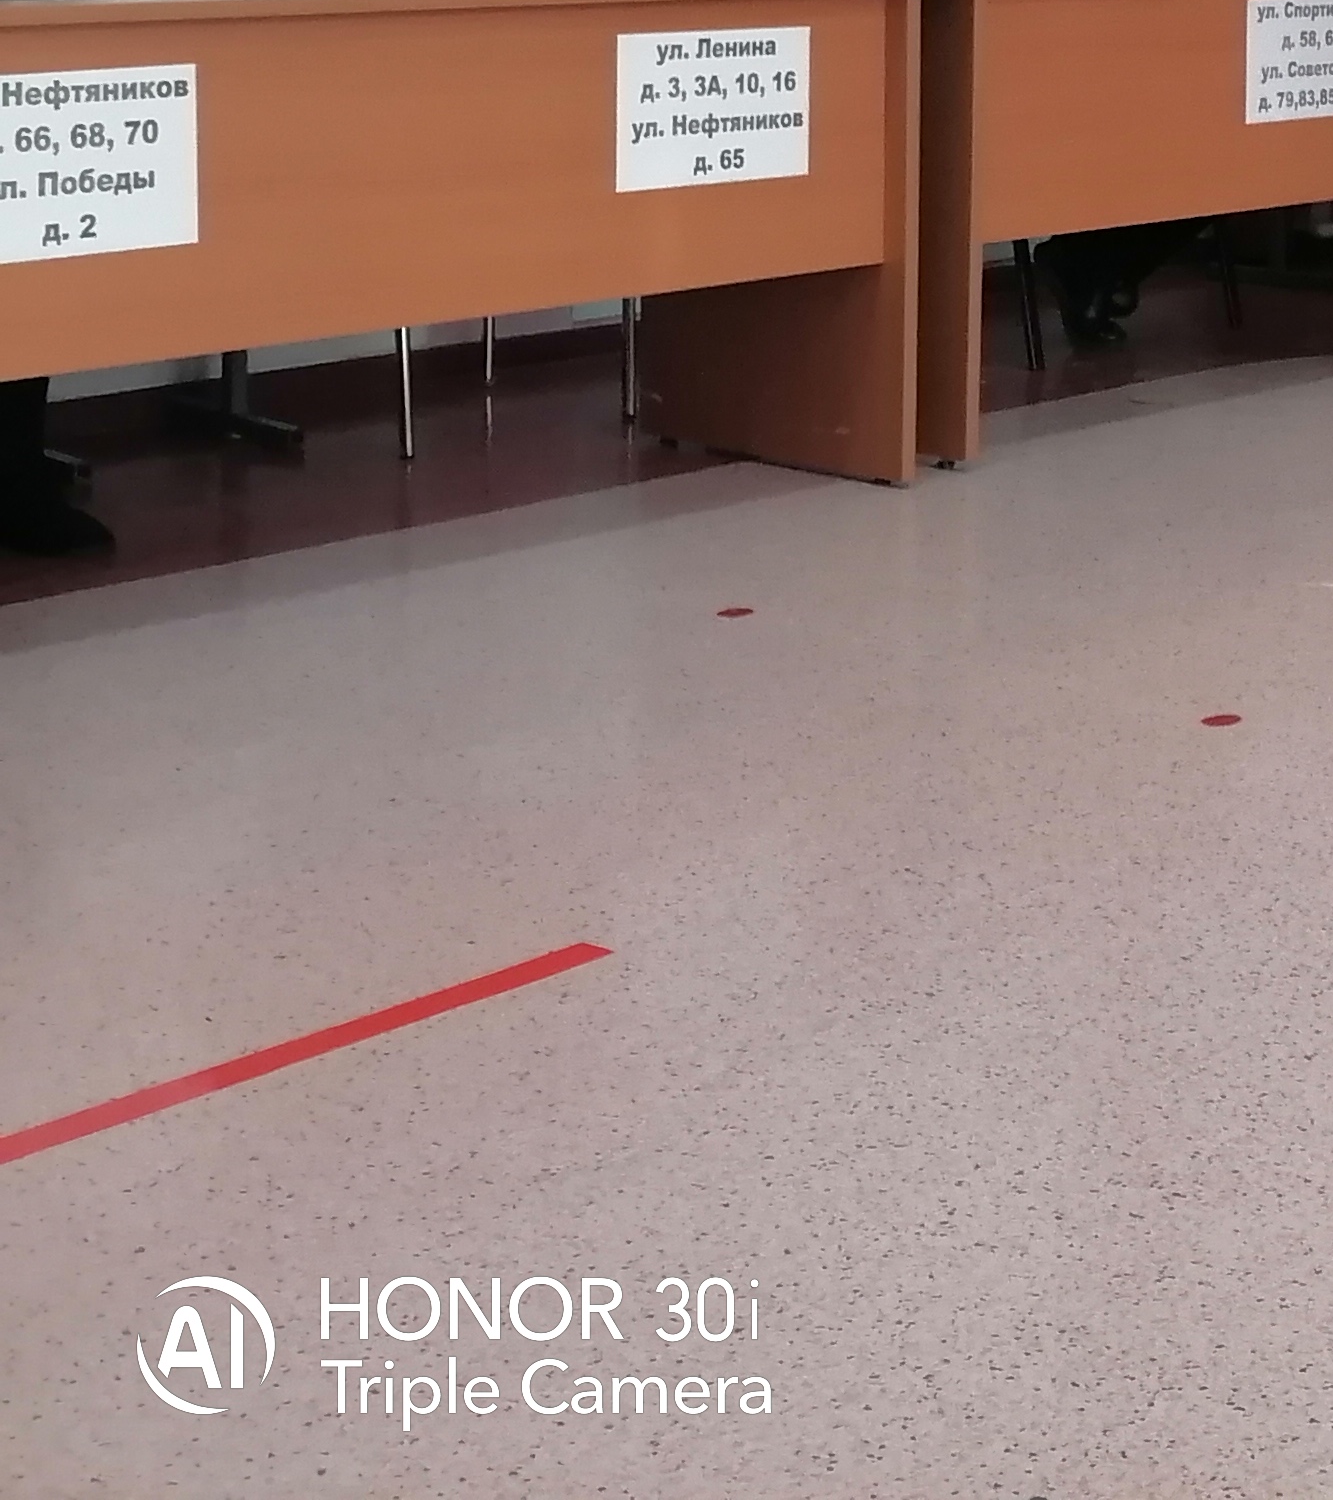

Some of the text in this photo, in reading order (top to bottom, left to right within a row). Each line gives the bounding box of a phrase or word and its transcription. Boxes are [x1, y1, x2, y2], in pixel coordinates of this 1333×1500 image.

[1257, 6, 1279, 23] ул.
[656, 38, 777, 66] ул. Ленина
[1281, 35, 1295, 51] д.
[1300, 30, 1321, 50] 58,
[640, 71, 797, 104] д. 3, 3А, 10, 16
[1261, 66, 1283, 84] ул.
[1, 79, 189, 111] Нефтяников
[1258, 97, 1272, 113] д.
[15, 119, 159, 156] 66, 68, 70
[631, 111, 804, 145] ул. Нефтяников
[693, 148, 745, 177] д. 65
[38, 168, 156, 197] Победы
[41, 214, 98, 247] д. 2
